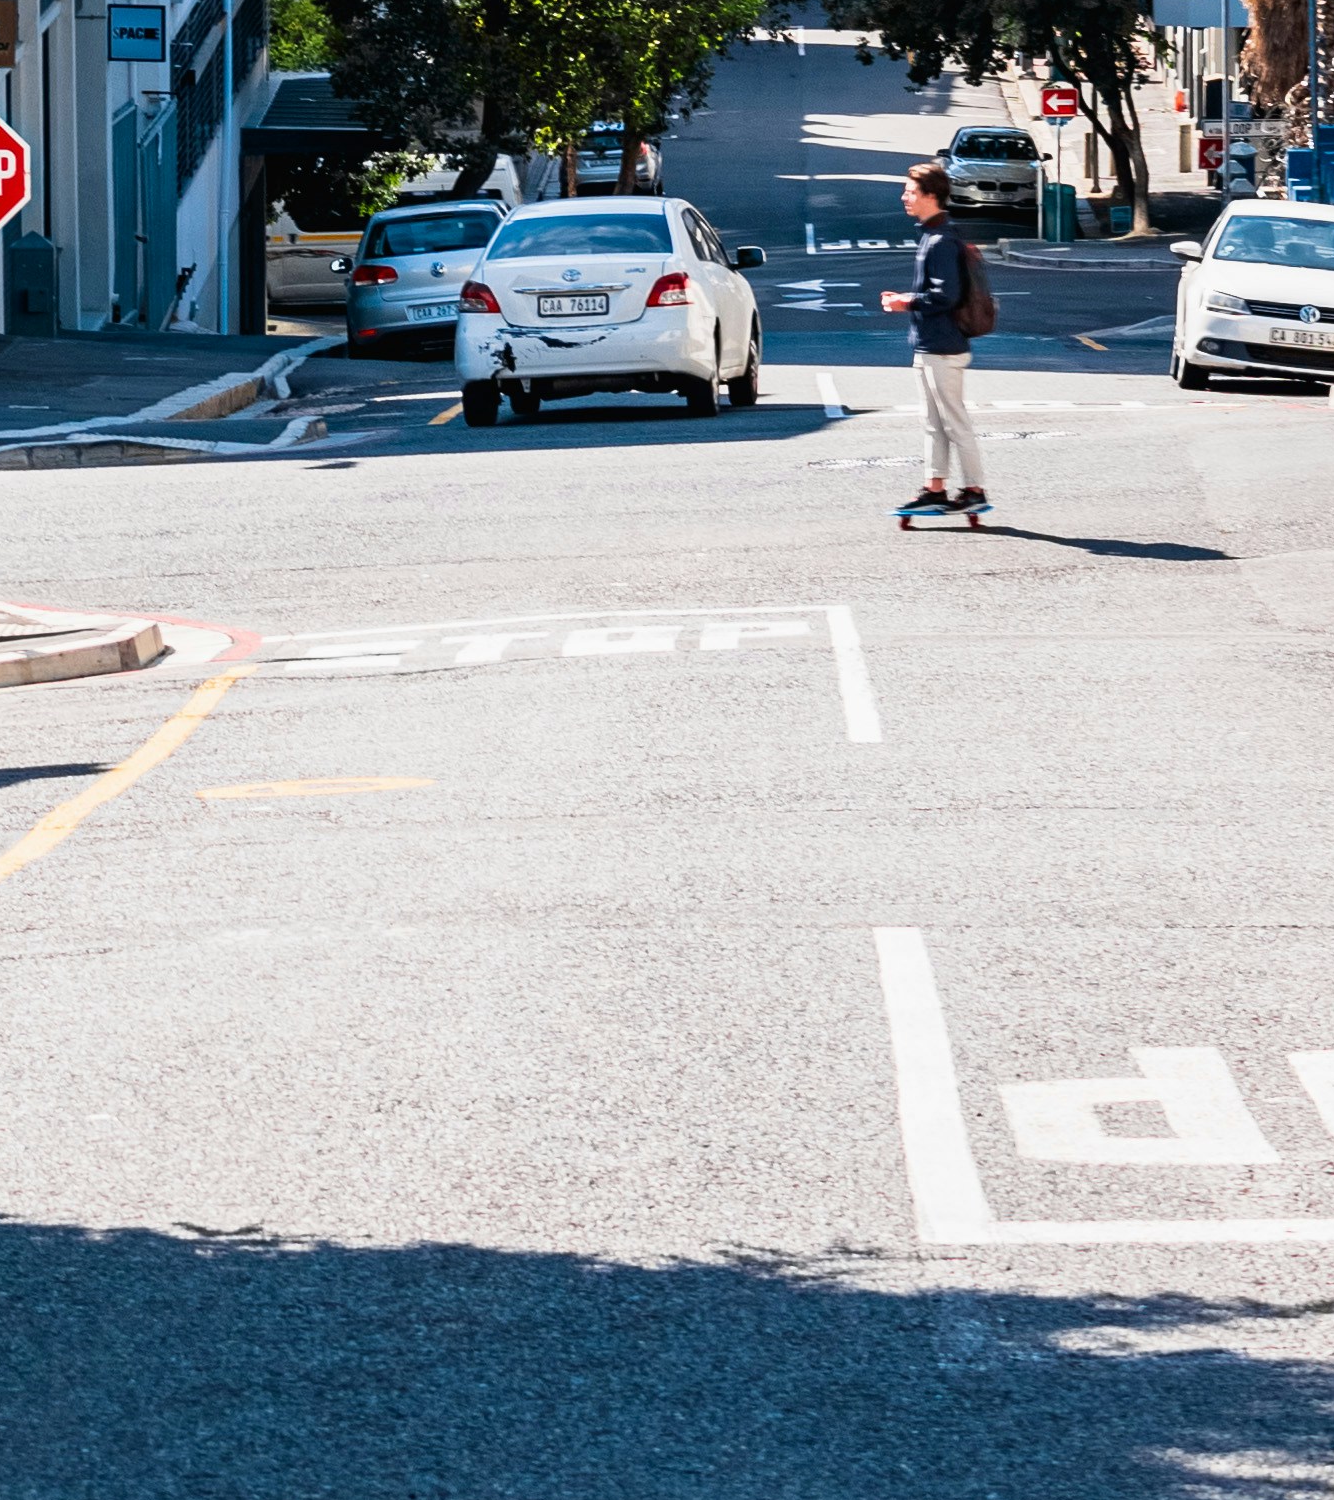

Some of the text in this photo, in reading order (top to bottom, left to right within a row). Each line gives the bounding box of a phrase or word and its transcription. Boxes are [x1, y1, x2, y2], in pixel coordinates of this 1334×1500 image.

[542, 298, 604, 313] CAA 76114
[1271, 330, 1286, 341] CA
[284, 619, 810, 672] STOP
